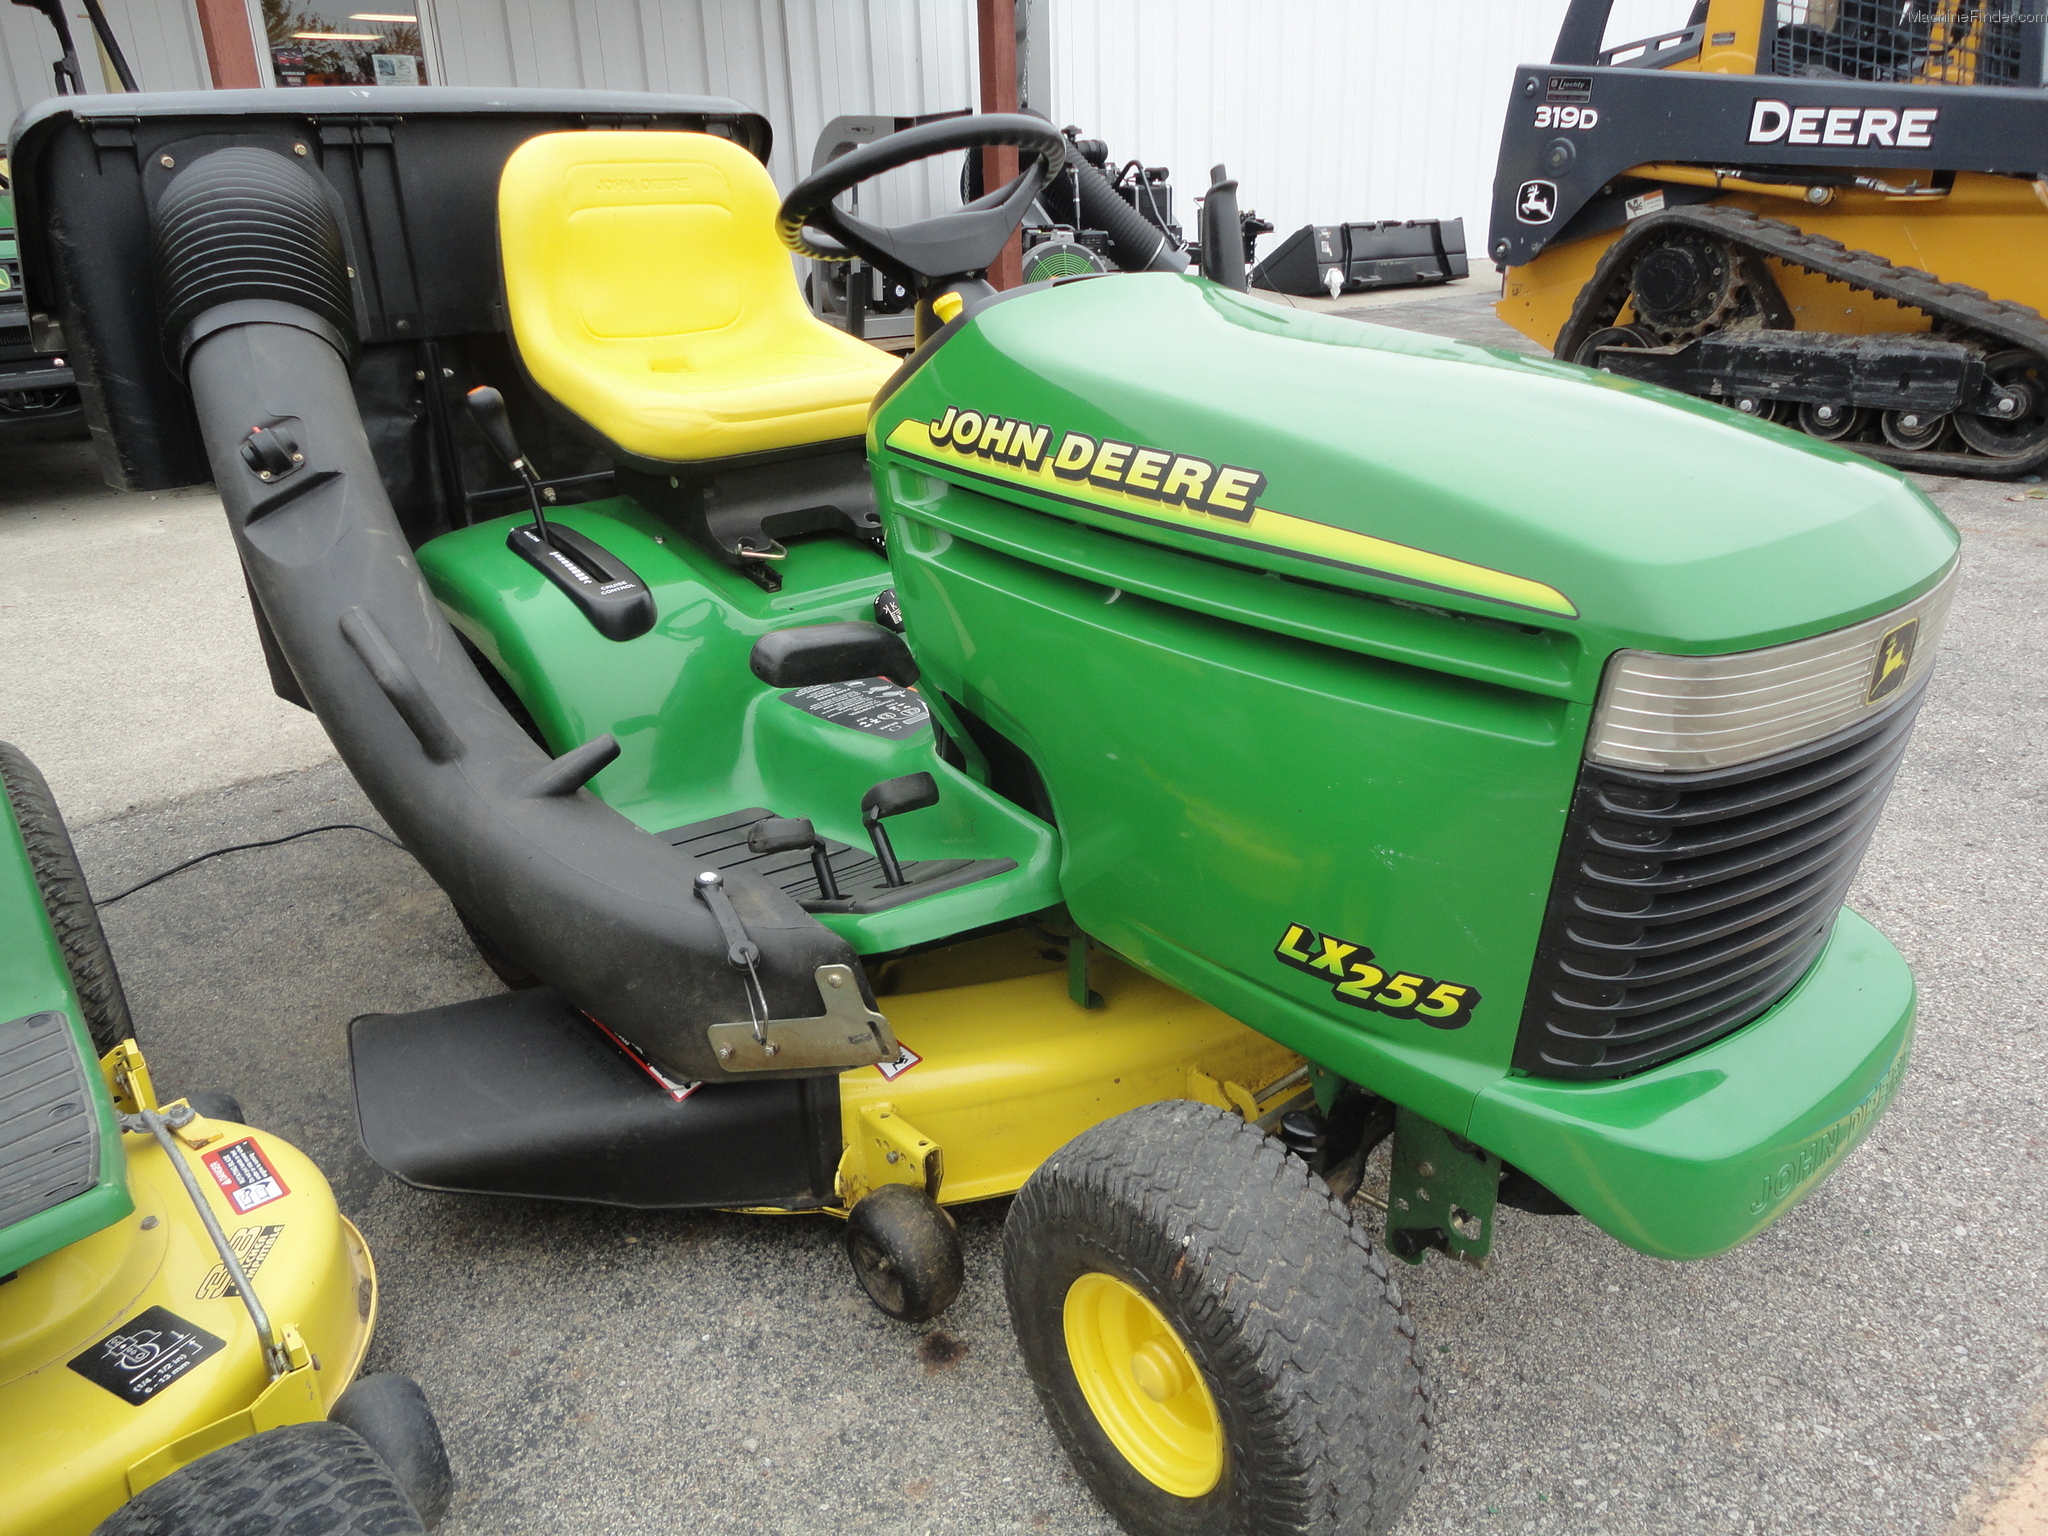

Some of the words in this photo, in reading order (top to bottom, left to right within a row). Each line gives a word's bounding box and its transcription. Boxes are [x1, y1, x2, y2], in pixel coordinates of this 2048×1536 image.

[1533, 105, 1599, 129] 319D
[1747, 99, 1939, 148] DEERE
[596, 178, 637, 192] JOHN
[640, 176, 690, 191] DEERE
[929, 406, 1052, 467] JOHN
[1052, 431, 1264, 518] DEERE
[600, 583, 637, 596] CONTROL
[1275, 923, 1477, 1025] LX255
[210, 1160, 228, 1181] DANGER
[1750, 1123, 1840, 1215] JOHN
[236, 1226, 281, 1295] MPATIBLE
